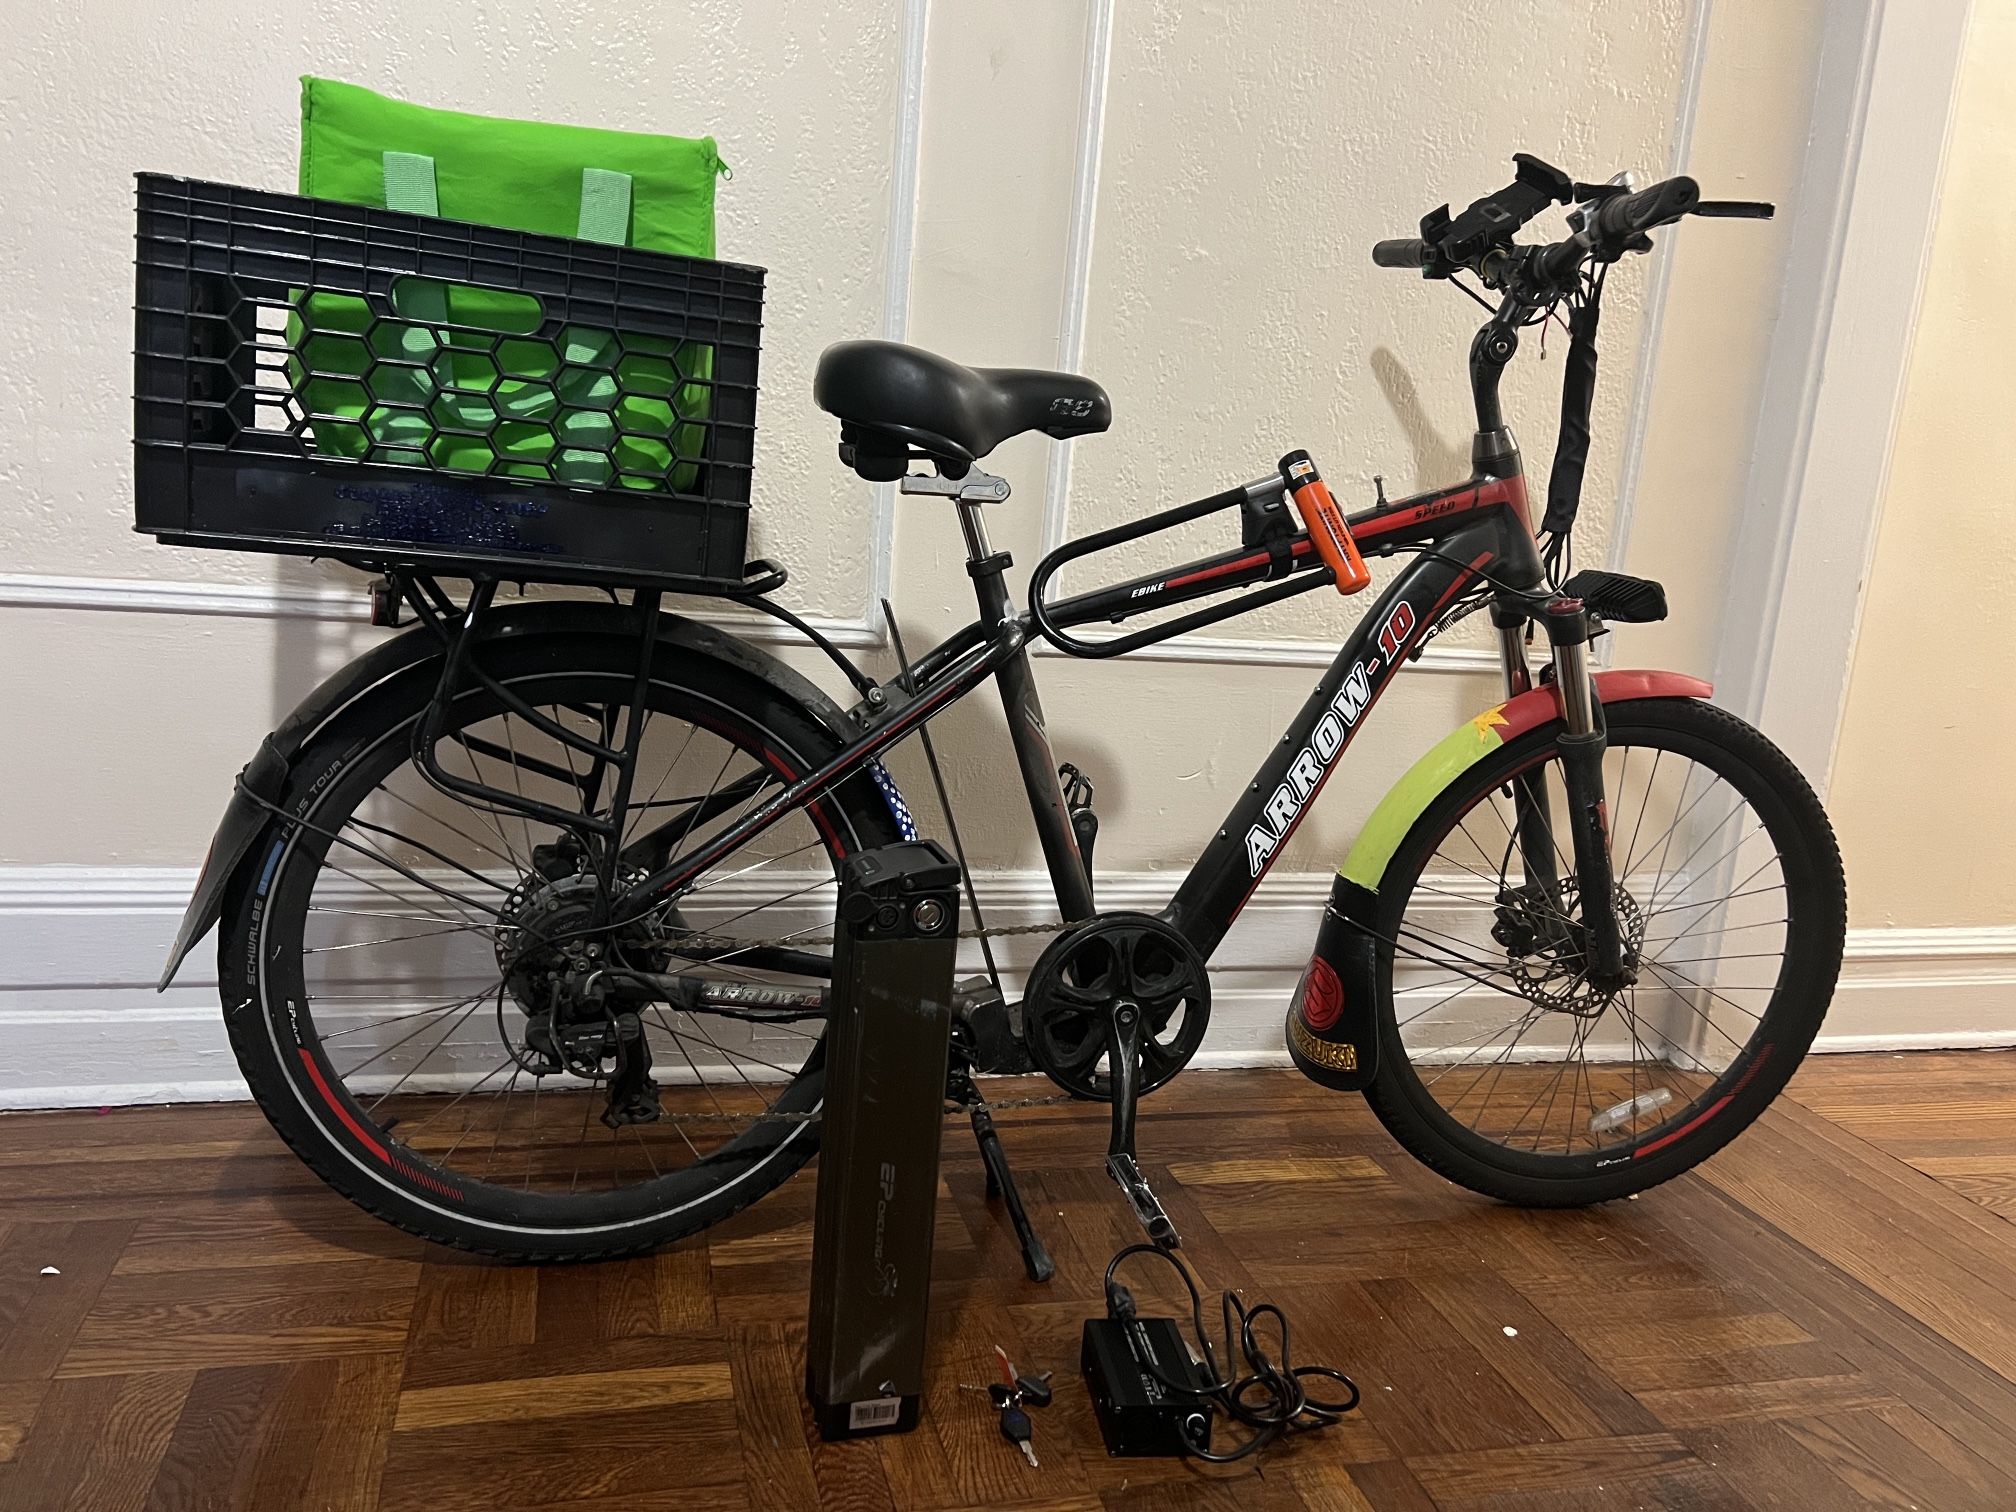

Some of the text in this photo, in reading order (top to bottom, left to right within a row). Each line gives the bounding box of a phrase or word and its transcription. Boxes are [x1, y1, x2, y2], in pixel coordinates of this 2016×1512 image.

[1414, 500, 1456, 520] SPEED
[1130, 581, 1166, 599] EBIKE
[1245, 600, 1415, 877] ARROW-10
[281, 760, 342, 840] PLUS TOUR
[247, 898, 263, 987] SCHWALBE
